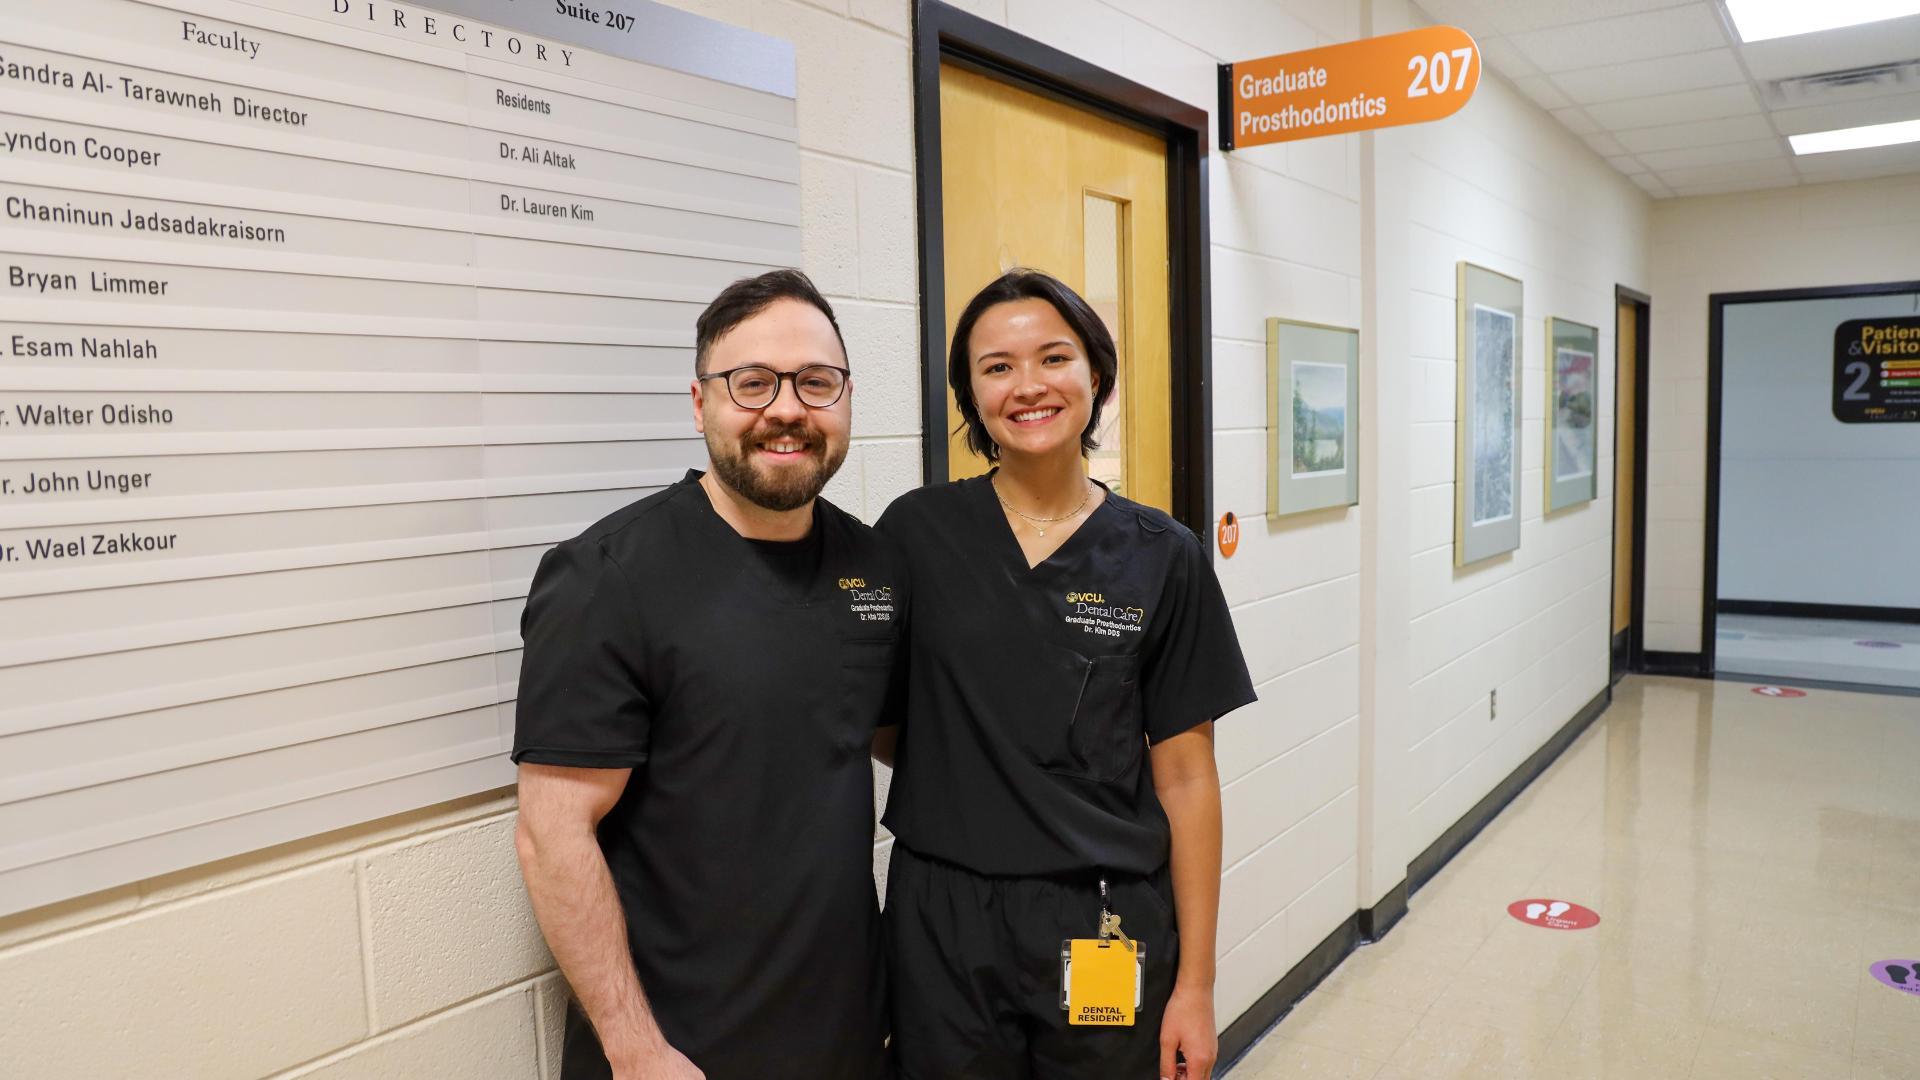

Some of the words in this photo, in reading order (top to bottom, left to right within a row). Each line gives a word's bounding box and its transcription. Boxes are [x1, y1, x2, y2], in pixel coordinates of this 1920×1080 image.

[556, 0, 600, 23] Suite
[605, 11, 635, 33] 207
[181, 21, 262, 59] Faculty
[333, 0, 574, 66] DIRECTORY
[1240, 66, 1327, 99] Graduate
[1407, 47, 1473, 99] 207
[82, 71, 113, 93] Al-
[119, 76, 222, 112] Tarawneh
[233, 97, 309, 126] Director
[496, 89, 551, 115] Residents
[1240, 93, 1387, 136] Prosthodontics
[84, 138, 161, 168] Cooper
[499, 142, 518, 161] Dr.
[522, 145, 539, 164] Ali
[543, 150, 576, 170] Altak
[6, 196, 114, 228] Chaninun
[121, 209, 285, 243] Jadsadakraisorn
[501, 194, 519, 212] Dr.
[522, 197, 567, 219] Lauren
[571, 204, 594, 221] Kim
[9, 265, 77, 293] Bryan
[91, 271, 168, 295] Limmer
[11, 335, 74, 358] Esam
[81, 337, 158, 359] Nahlah
[1843, 361, 1871, 400] 2
[16, 404, 94, 426] Walter
[101, 403, 174, 425] Odisho
[23, 471, 80, 494] John
[87, 470, 152, 493] Unger
[0, 543, 19, 562] r.
[26, 536, 86, 560] Wael
[91, 532, 177, 556] Zakkour
[1222, 524, 1237, 545] 207
[847, 578, 865, 588] VCU
[1078, 592, 1102, 603] VCU
[1076, 602, 1112, 618] Dental
[1113, 607, 1138, 621] Care
[1096, 618, 1142, 632] Prosthodontics
[1095, 626, 1107, 636] Kim
[1107, 628, 1120, 638] DDS
[1078, 1014, 1126, 1022] RESIDENT
[1083, 1006, 1122, 1014] DENTAL
